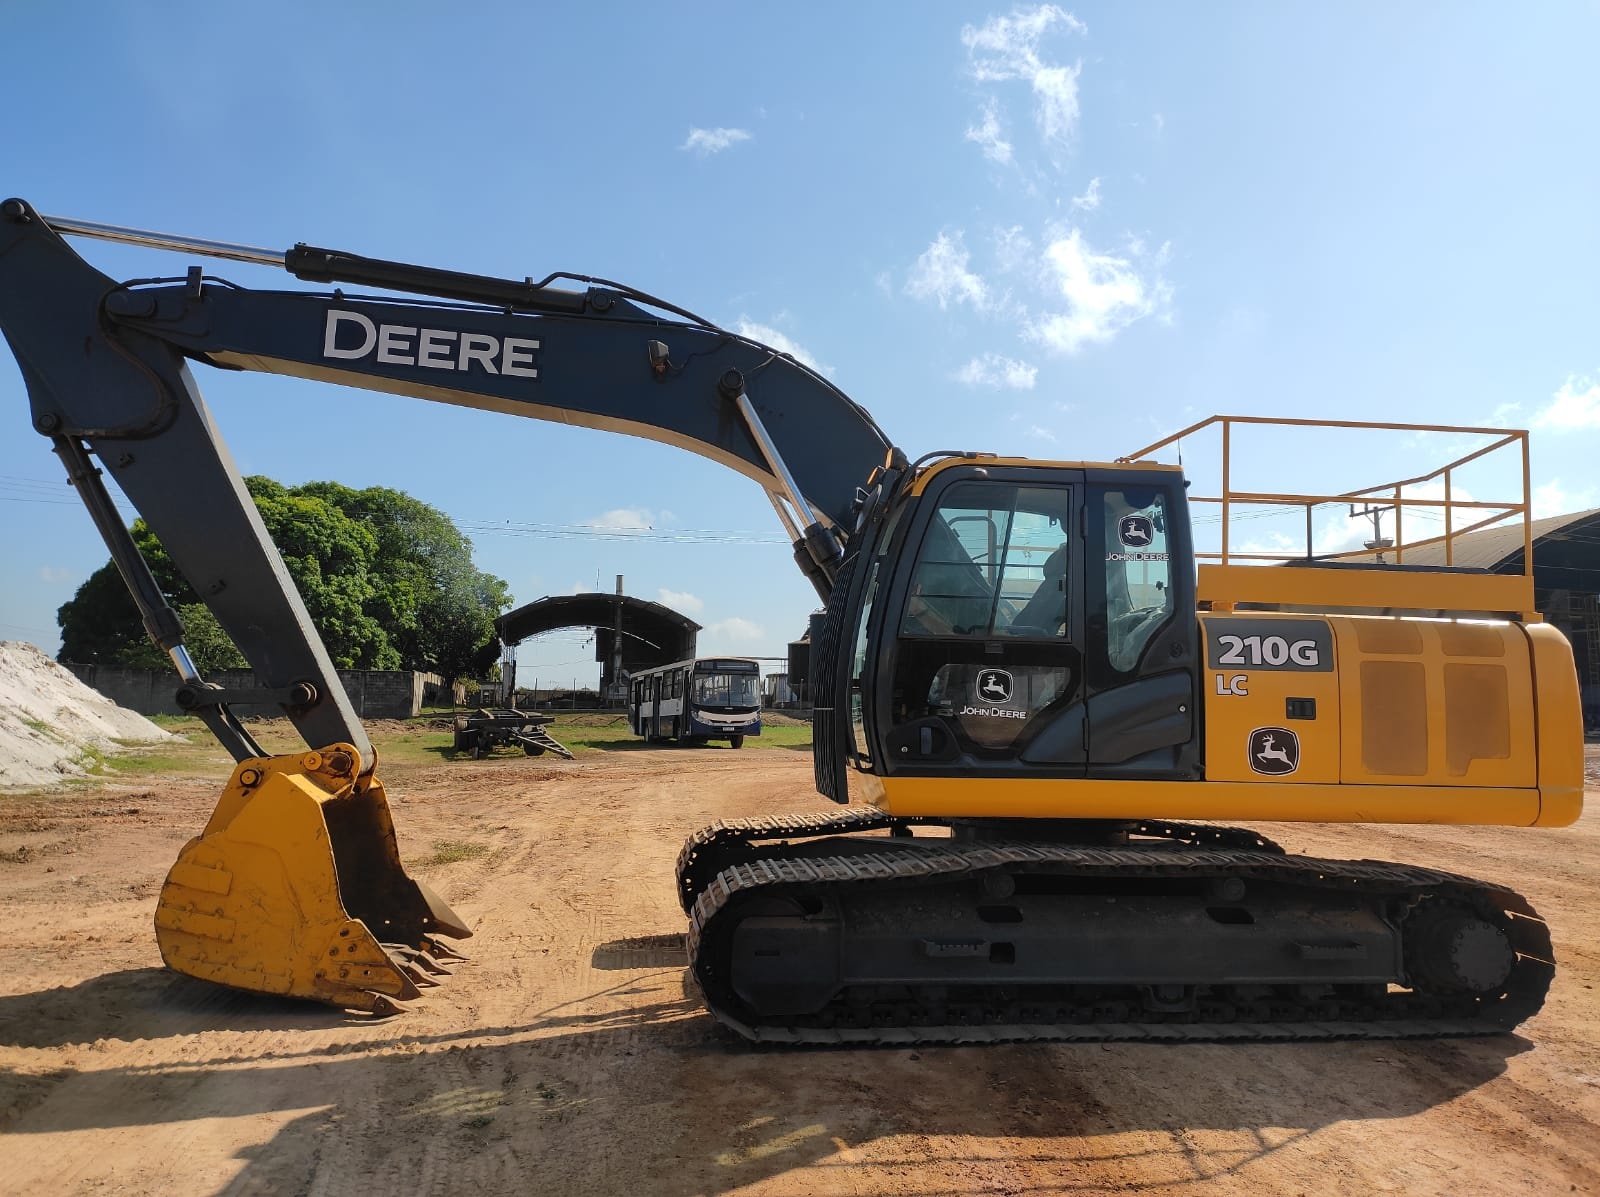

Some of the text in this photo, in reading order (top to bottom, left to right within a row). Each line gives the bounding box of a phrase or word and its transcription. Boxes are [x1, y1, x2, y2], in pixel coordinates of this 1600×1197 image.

[323, 309, 540, 378] DEERE
[1105, 552, 1169, 561] JOHN DEERE
[1217, 635, 1319, 666] 210G
[1215, 674, 1248, 695] LC
[960, 706, 1026, 719] JOHN DEERE
